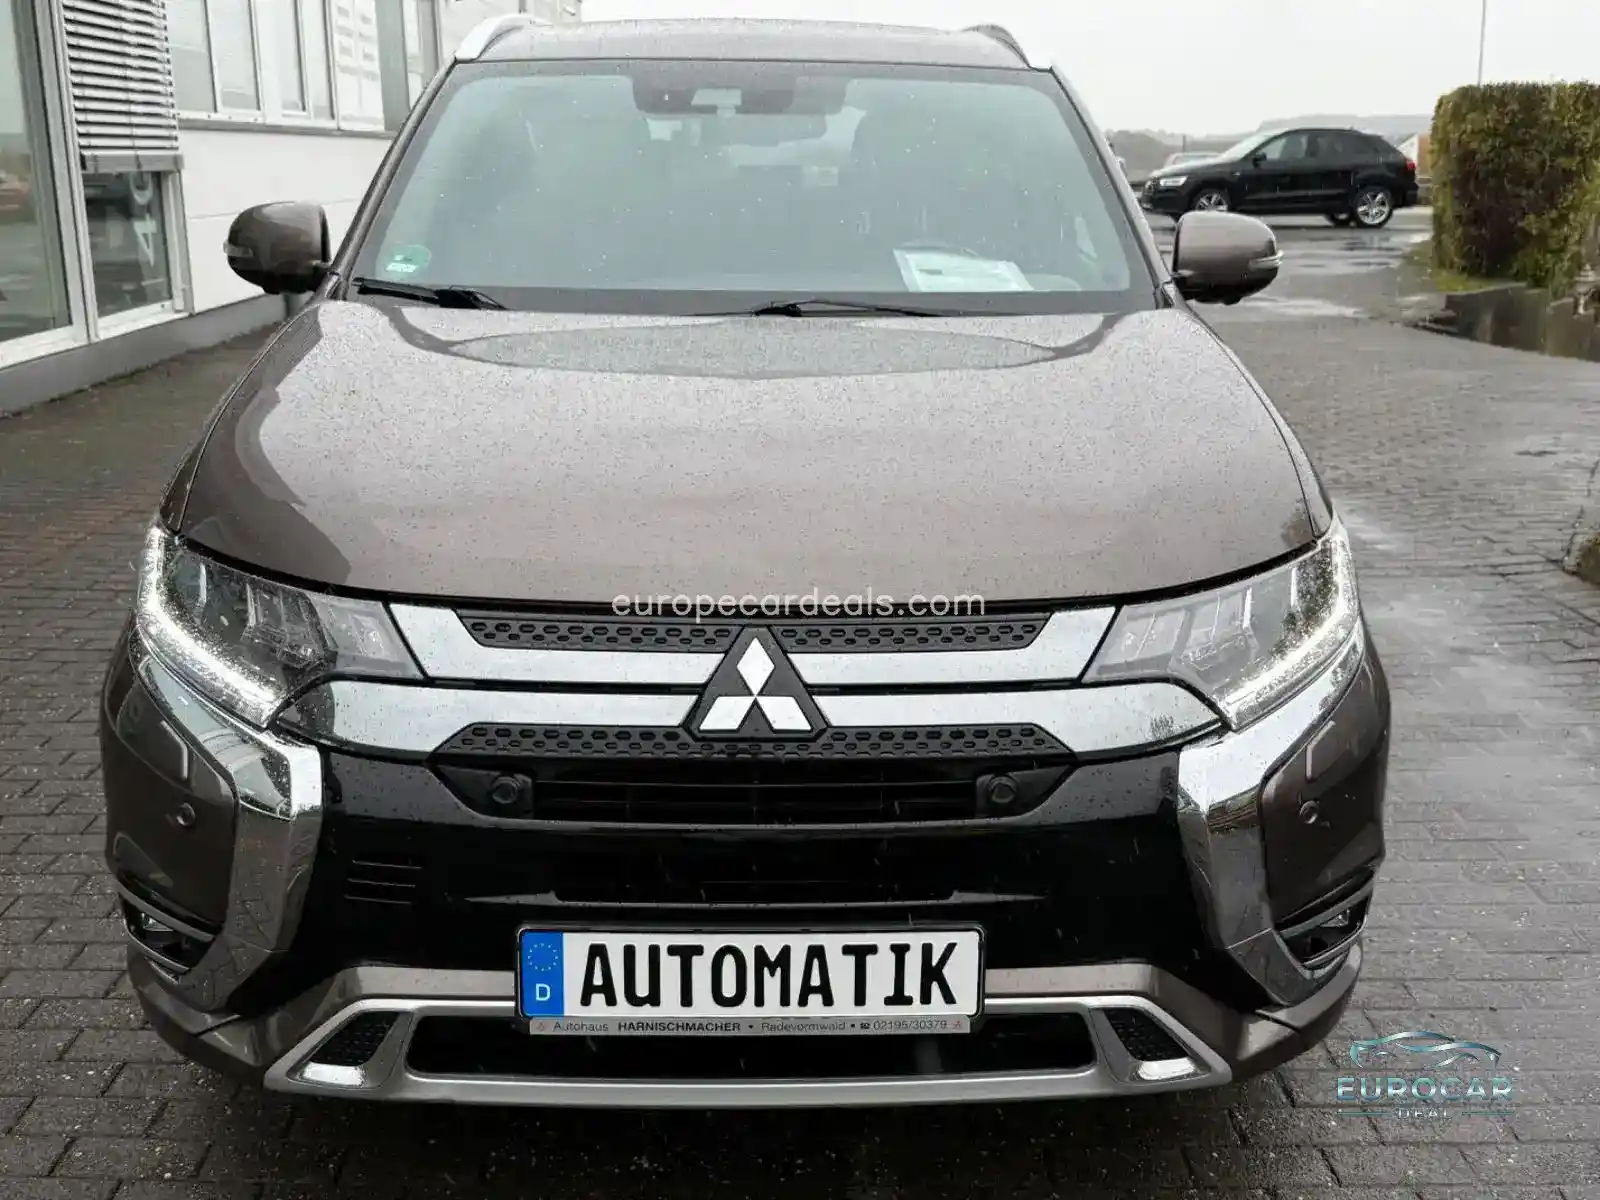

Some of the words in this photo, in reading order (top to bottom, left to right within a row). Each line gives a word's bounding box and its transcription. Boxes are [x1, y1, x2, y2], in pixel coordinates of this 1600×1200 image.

[579, 943, 957, 1007] AUTOMATIK
[535, 983, 551, 1001] D
[553, 1021, 609, 1033] Autohaus
[618, 1021, 741, 1033] HARNISCHMACHER
